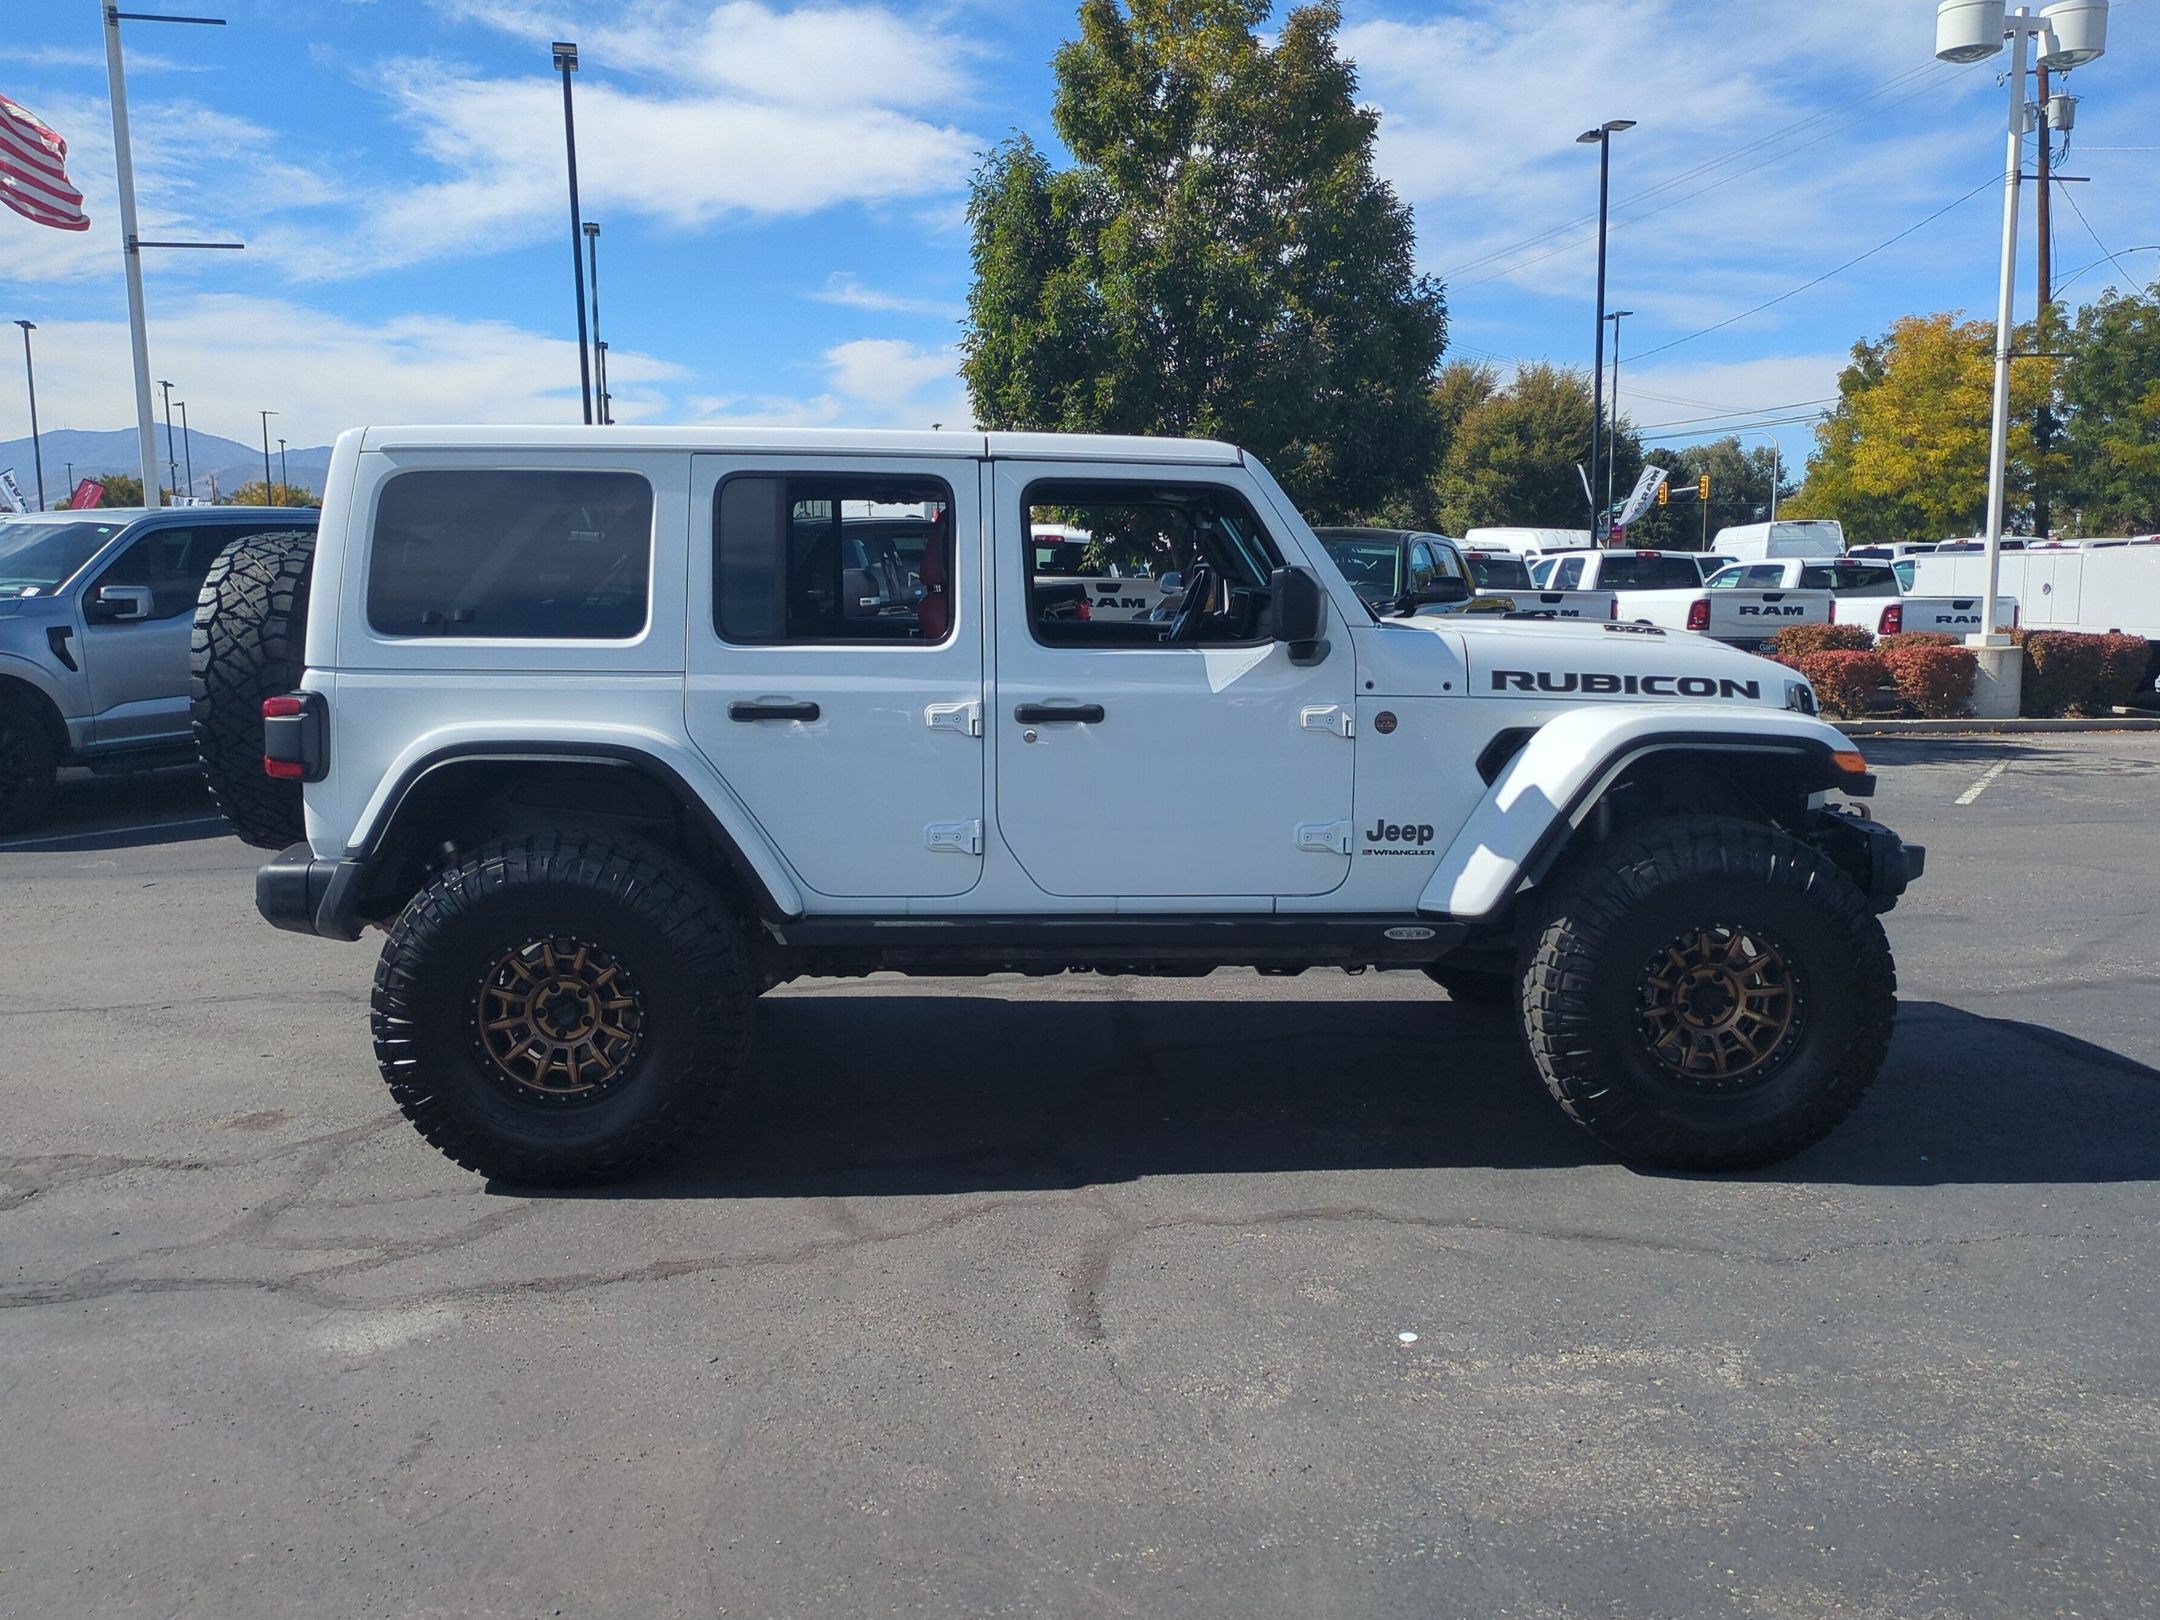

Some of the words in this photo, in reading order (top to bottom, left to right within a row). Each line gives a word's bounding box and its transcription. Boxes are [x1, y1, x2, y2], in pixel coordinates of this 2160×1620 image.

[1641, 469, 1661, 502] RAM
[1739, 606, 1804, 615] RAM
[1491, 669, 1761, 700] RUBICON
[1366, 819, 1435, 846] Jeep
